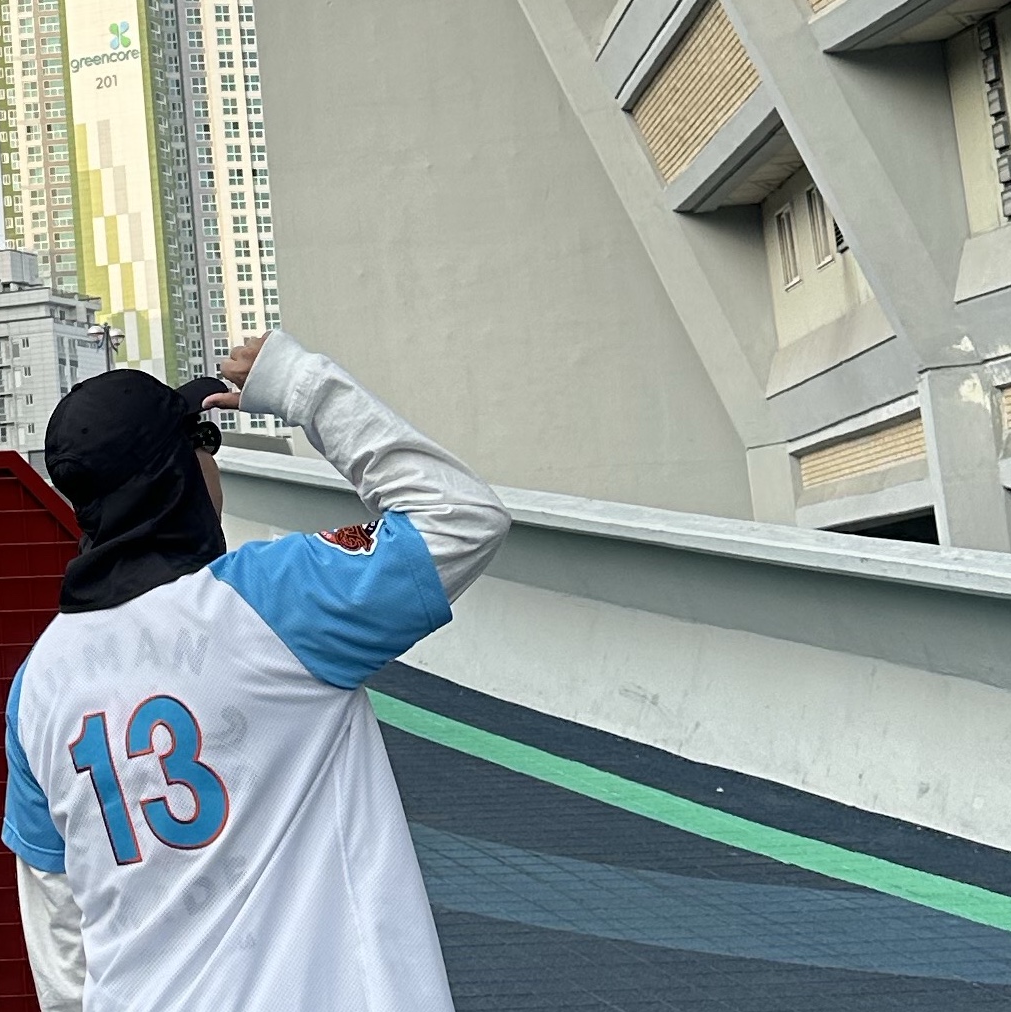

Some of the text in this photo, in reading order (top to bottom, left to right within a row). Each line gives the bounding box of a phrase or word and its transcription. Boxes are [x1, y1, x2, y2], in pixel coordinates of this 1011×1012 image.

[70, 49, 140, 73] greencore
[95, 74, 118, 89] 201
[69, 694, 230, 866] 13
